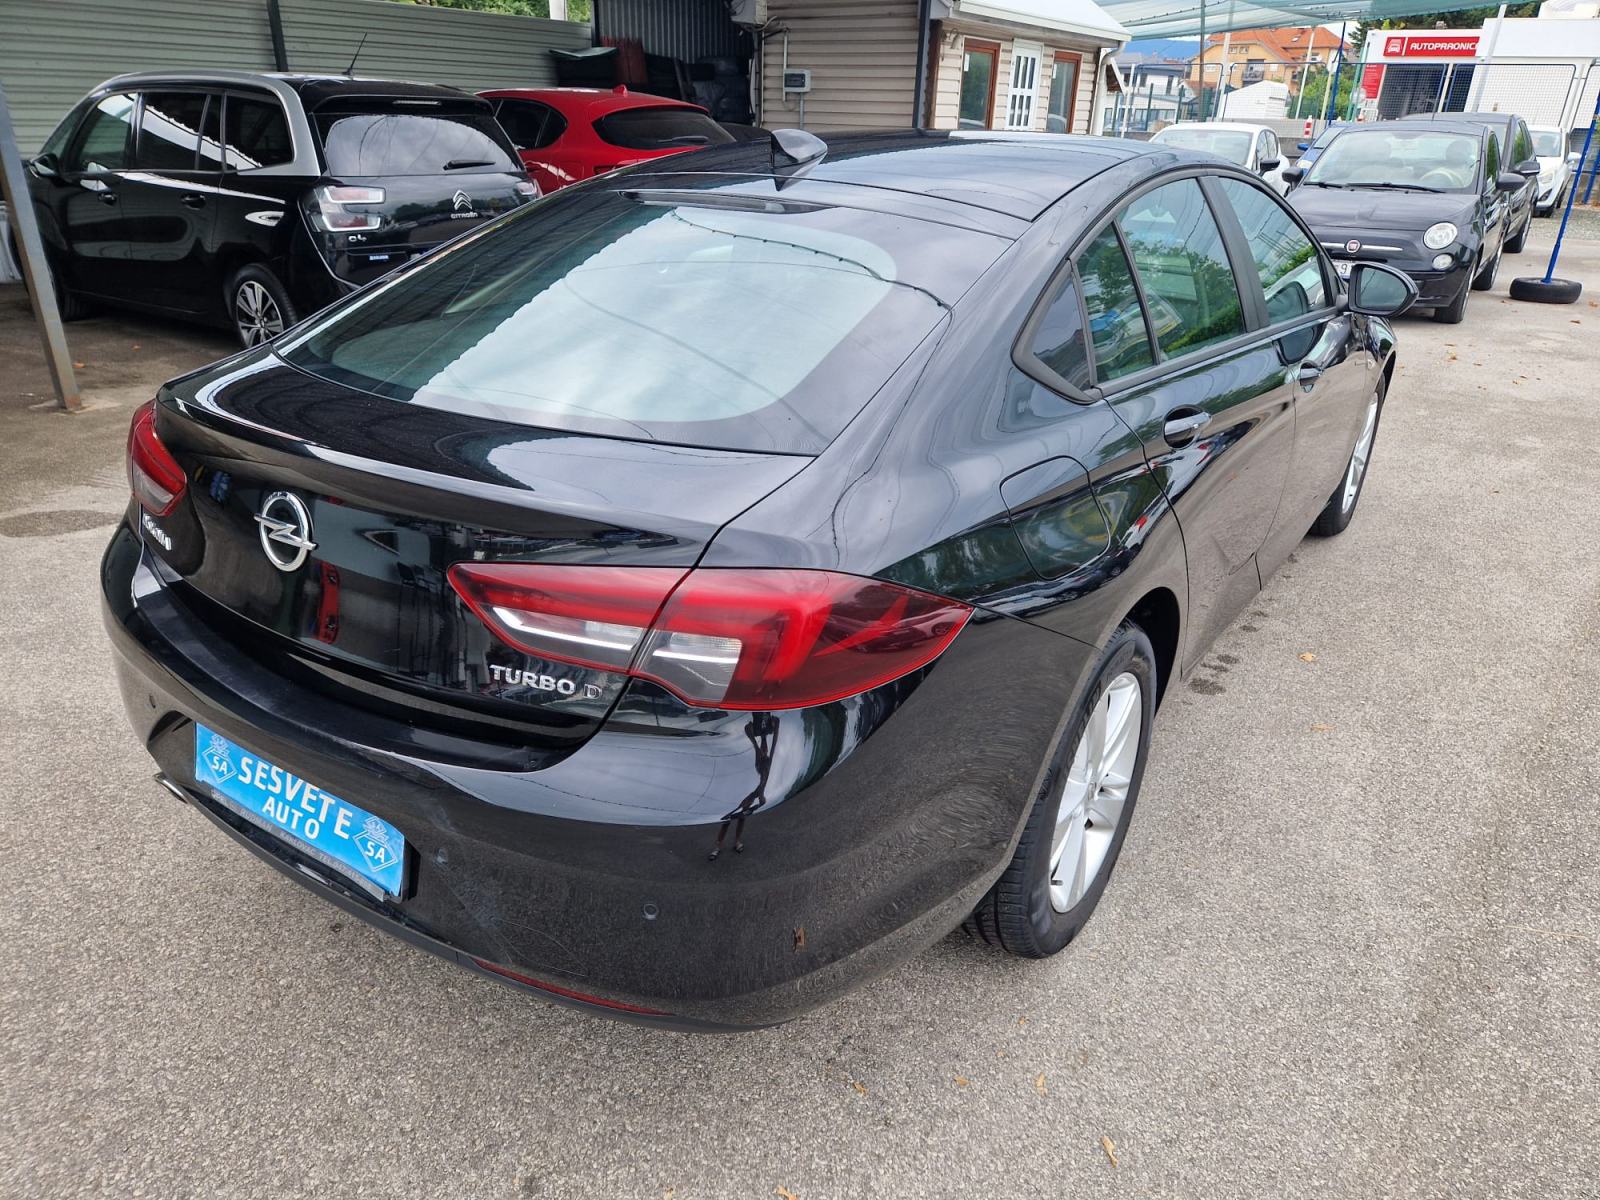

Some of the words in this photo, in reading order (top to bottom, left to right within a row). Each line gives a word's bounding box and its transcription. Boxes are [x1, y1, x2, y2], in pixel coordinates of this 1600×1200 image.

[489, 664, 576, 695] TURBO
[583, 683, 602, 699] D
[211, 755, 228, 776] SA
[238, 756, 353, 840] SESVETE
[262, 797, 320, 840] AUTO
[364, 841, 385, 863] SA
